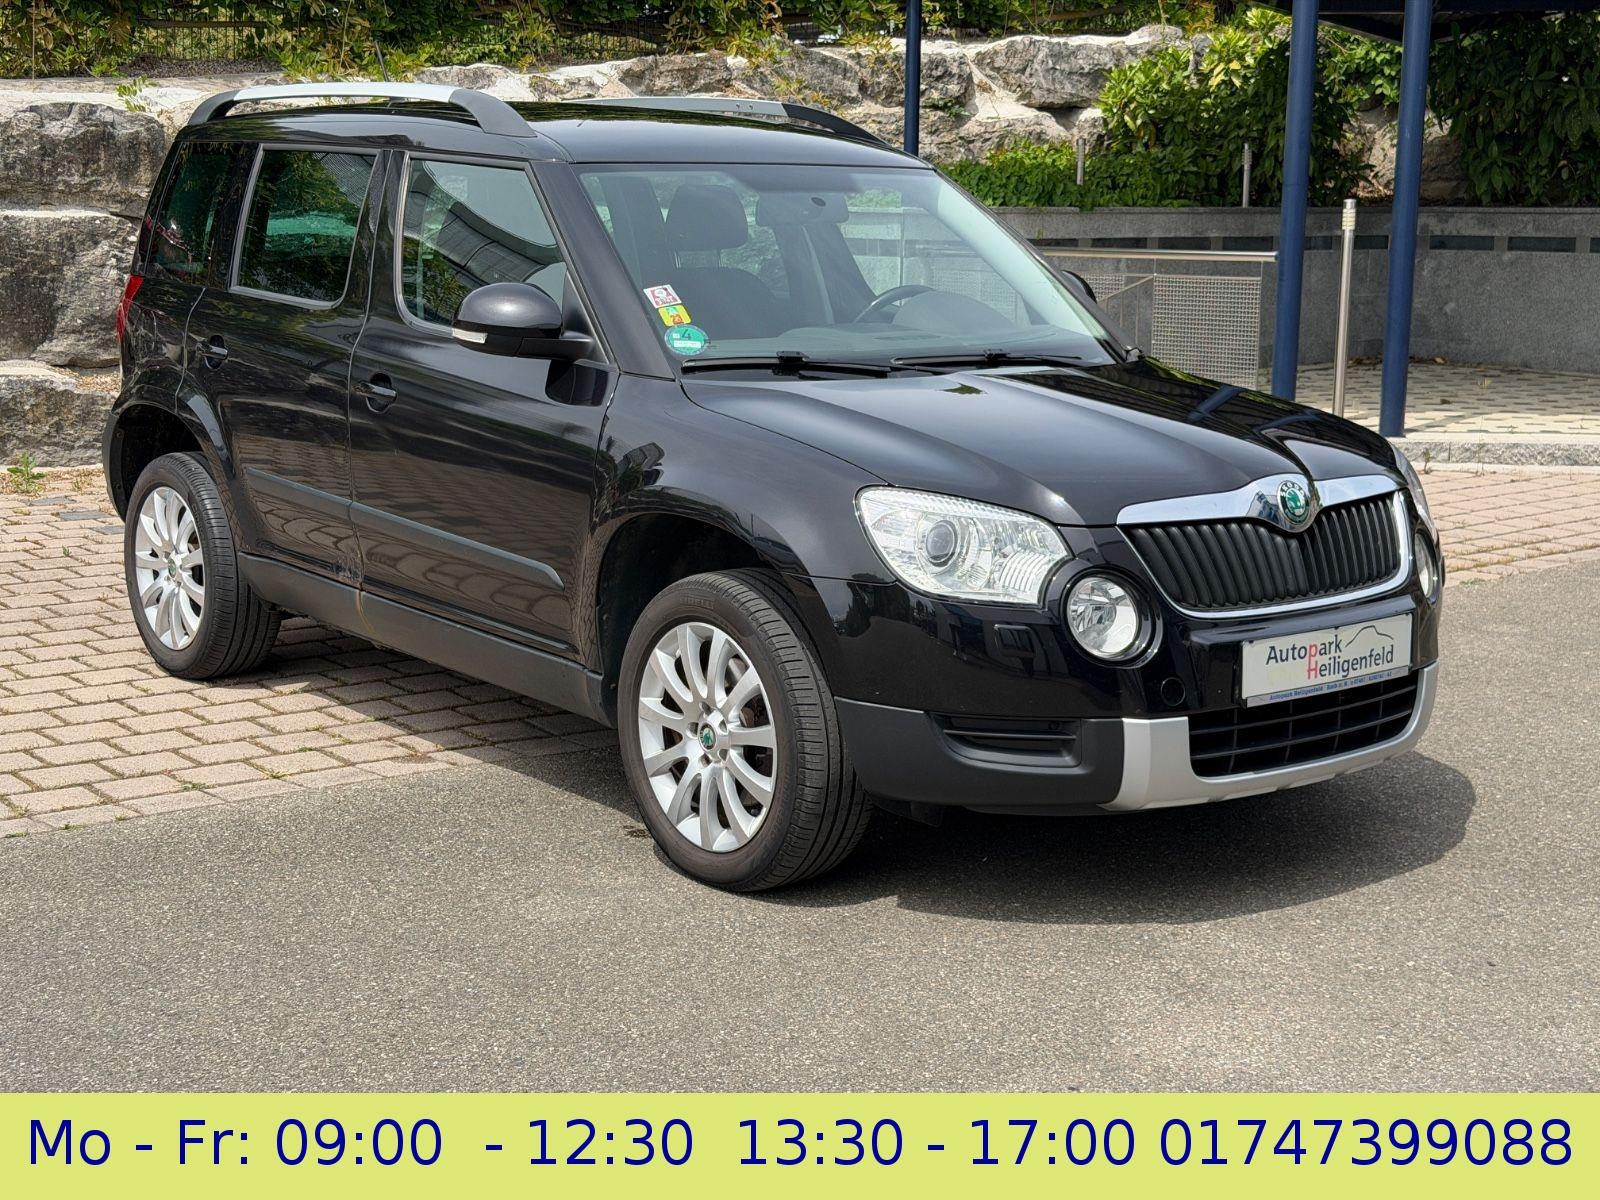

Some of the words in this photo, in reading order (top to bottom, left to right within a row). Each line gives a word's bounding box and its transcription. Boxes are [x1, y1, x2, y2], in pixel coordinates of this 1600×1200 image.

[682, 329, 692, 340] 4
[1266, 634, 1342, 666] Autopark
[1307, 644, 1394, 680] Heiligenfeld
